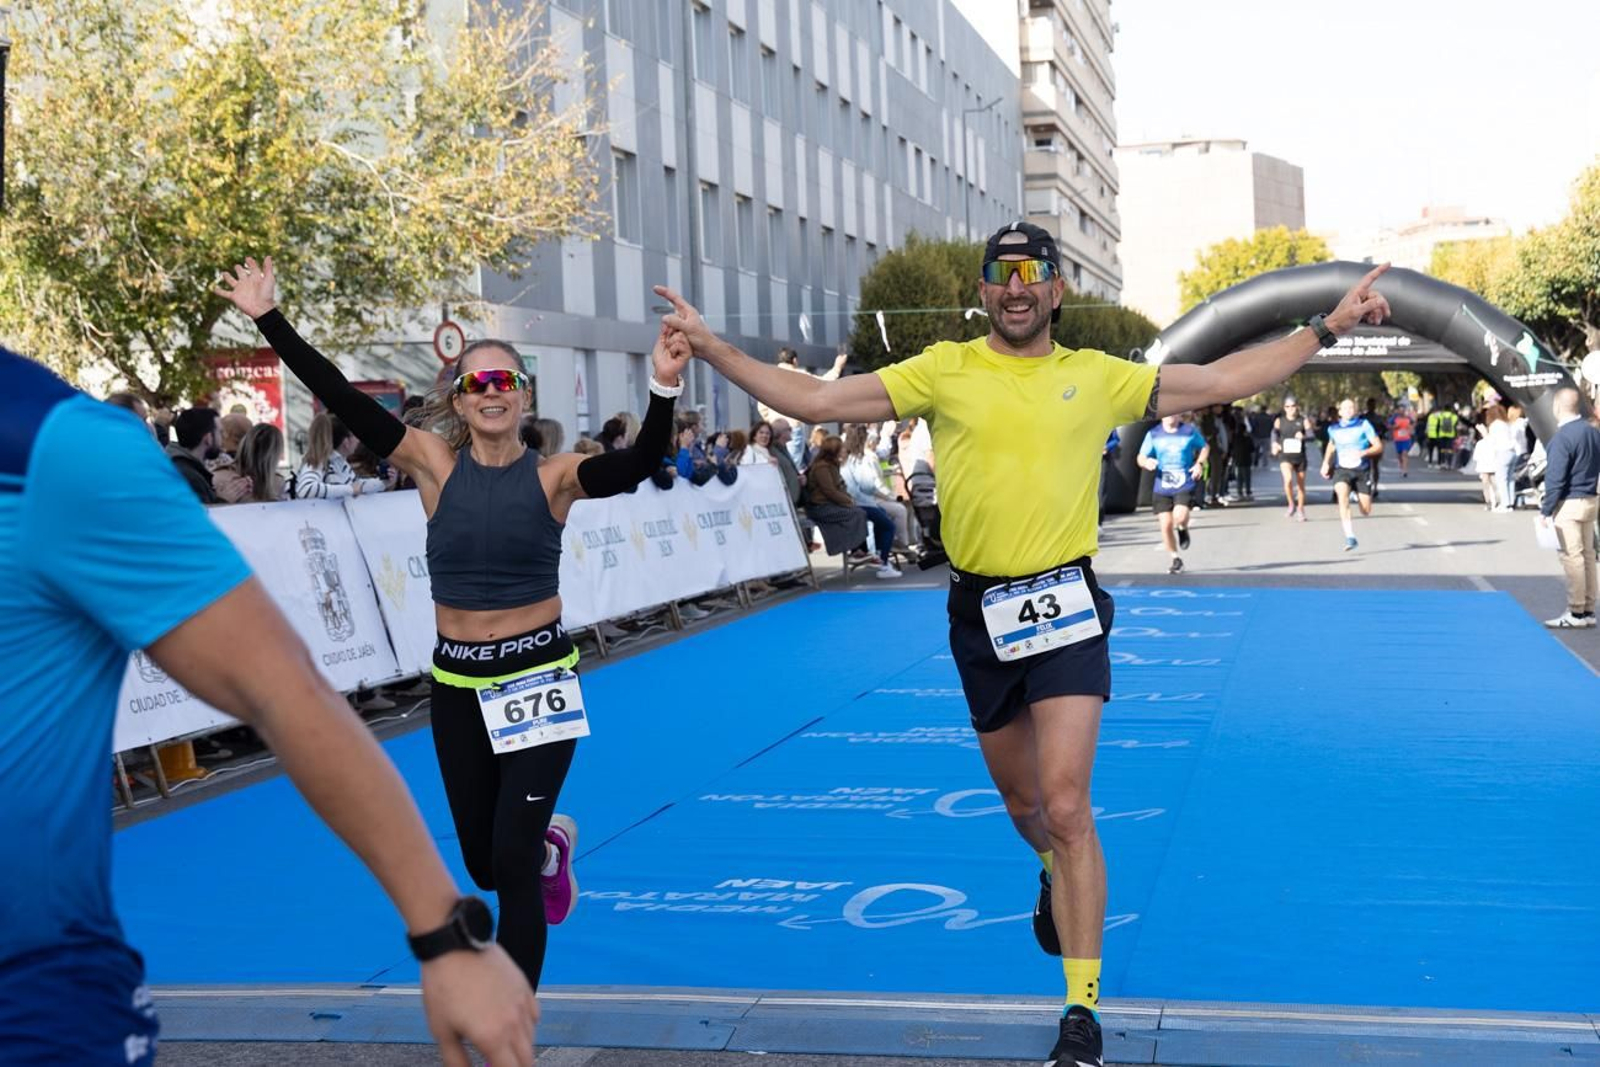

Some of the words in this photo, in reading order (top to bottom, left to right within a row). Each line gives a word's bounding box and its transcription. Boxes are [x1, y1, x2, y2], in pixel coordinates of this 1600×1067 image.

[1018, 593, 1062, 624] 43
[441, 642, 496, 660] NIKE
[500, 630, 552, 658] PRO
[129, 693, 167, 714] CIUDAD
[165, 689, 182, 704] DE
[504, 688, 566, 724] 676
[613, 901, 794, 914] MEDIA
